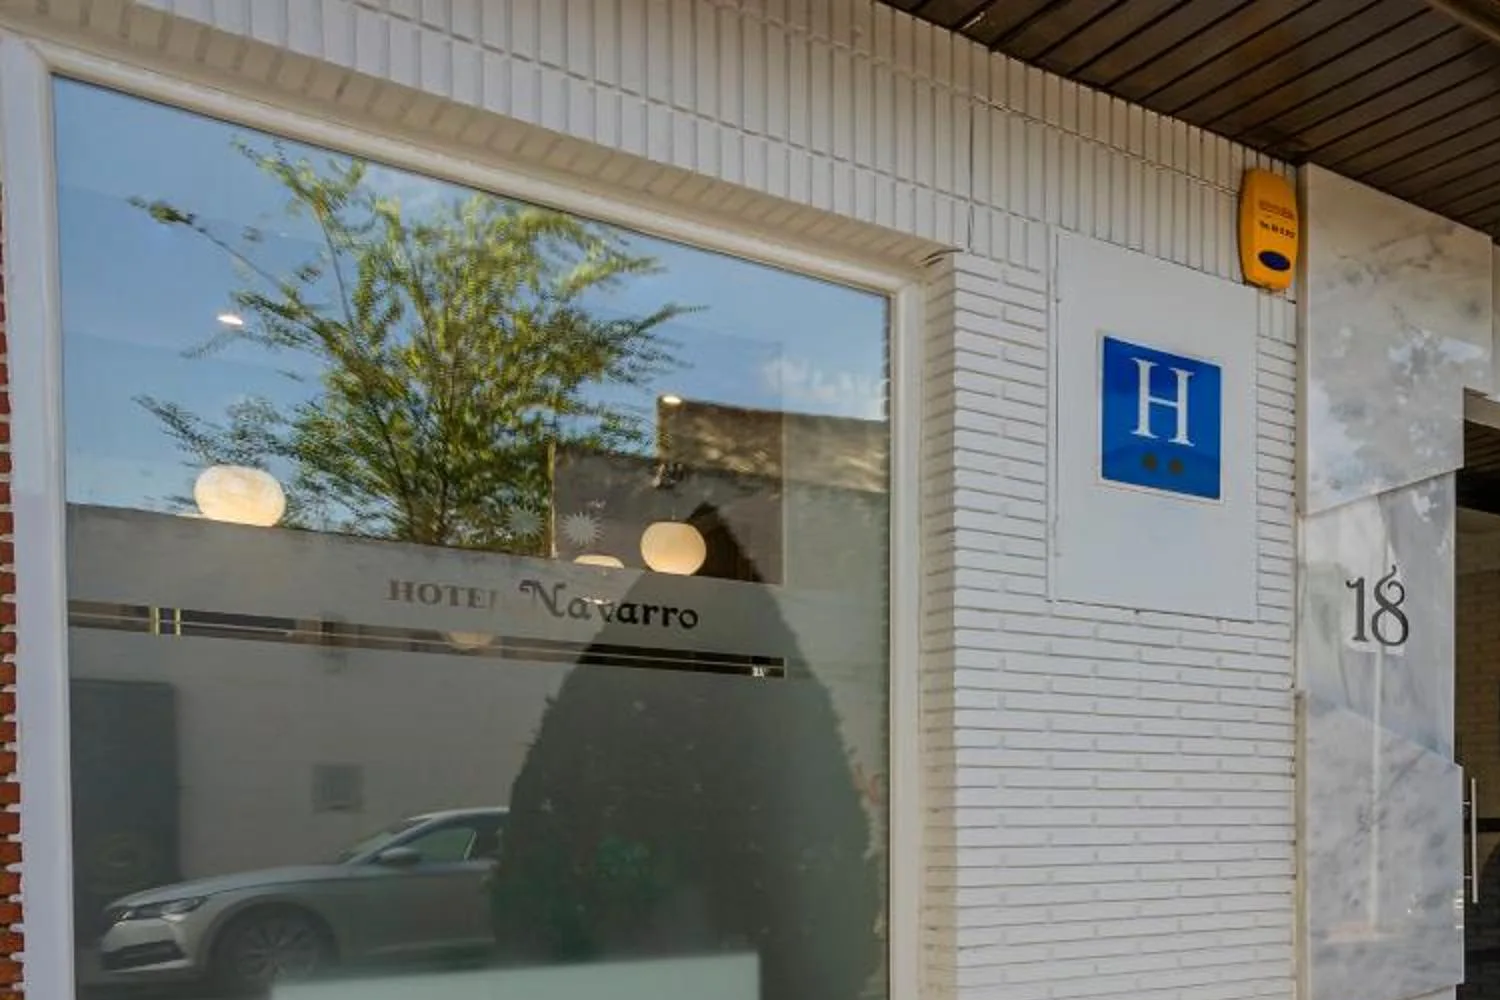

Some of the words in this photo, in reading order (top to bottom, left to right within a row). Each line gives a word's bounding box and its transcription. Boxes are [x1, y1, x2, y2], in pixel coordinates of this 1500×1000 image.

[1129, 356, 1197, 447] H
[518, 579, 699, 630] Navarro
[1345, 563, 1409, 647] 18
